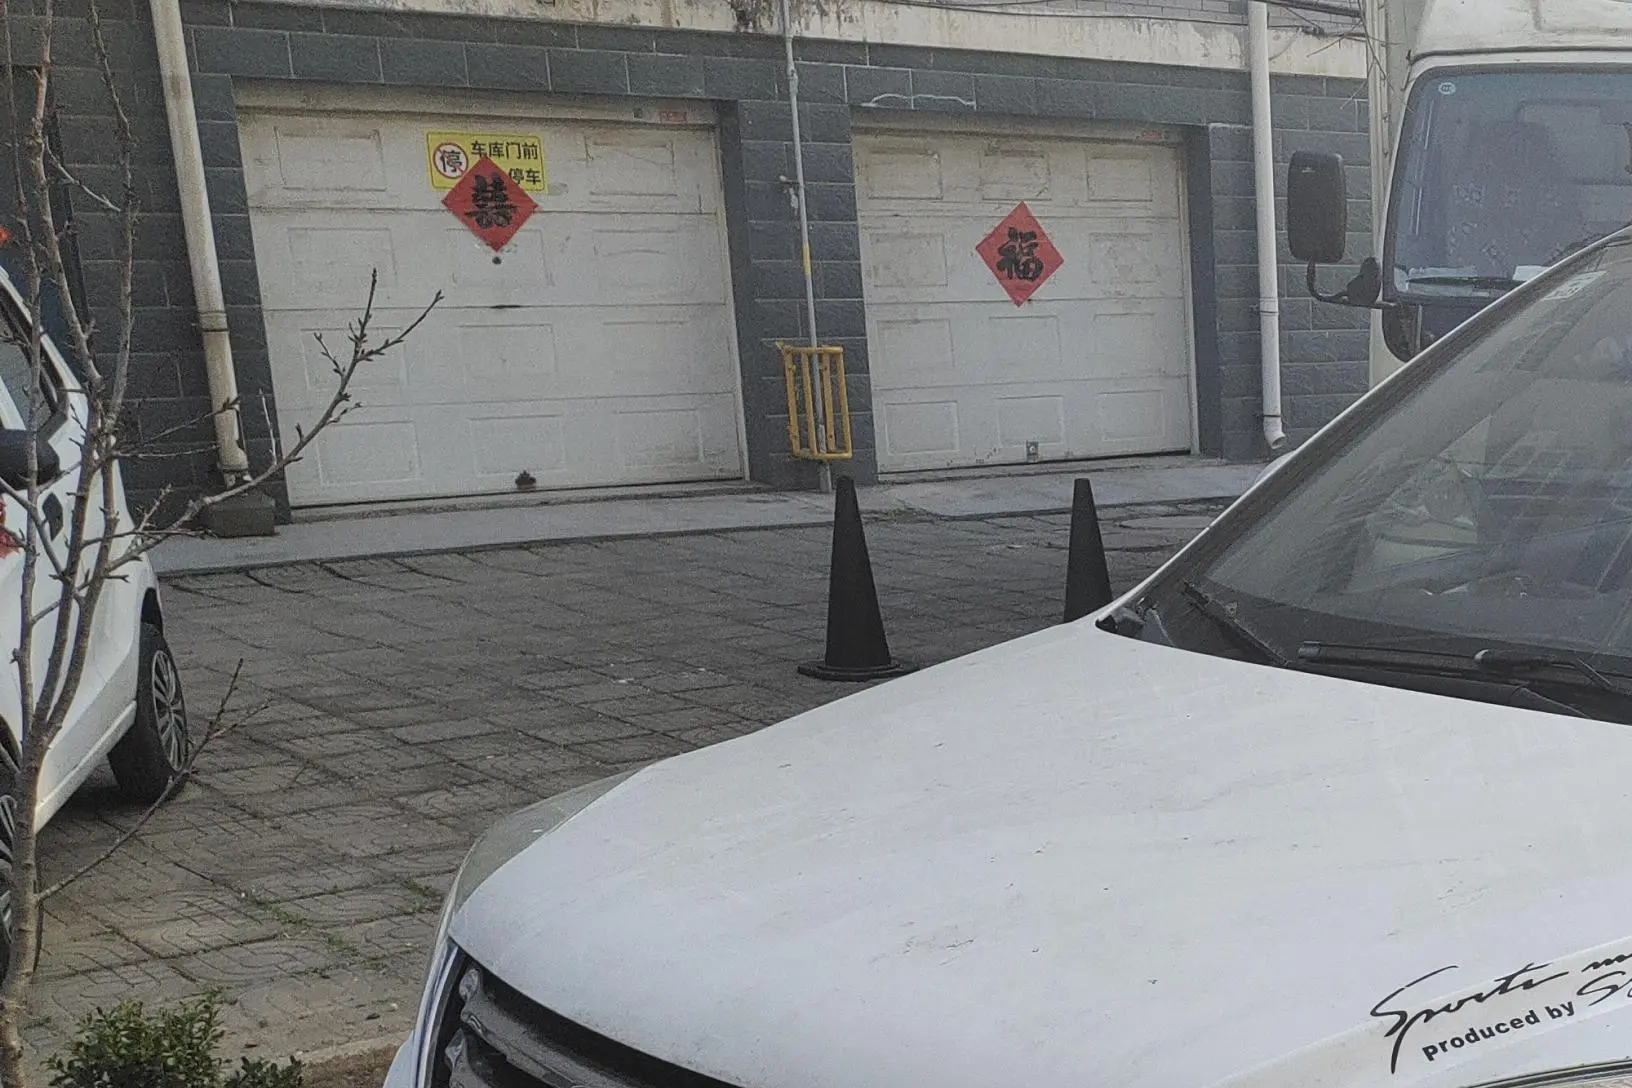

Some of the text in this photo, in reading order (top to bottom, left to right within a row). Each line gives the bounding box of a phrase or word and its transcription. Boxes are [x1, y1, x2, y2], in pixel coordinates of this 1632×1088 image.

[440, 150, 463, 172] 停
[470, 141, 538, 160] 车库门前
[996, 226, 1044, 282] 福
[1421, 1009, 1541, 1062] produced
[1545, 1000, 1576, 1021] by
